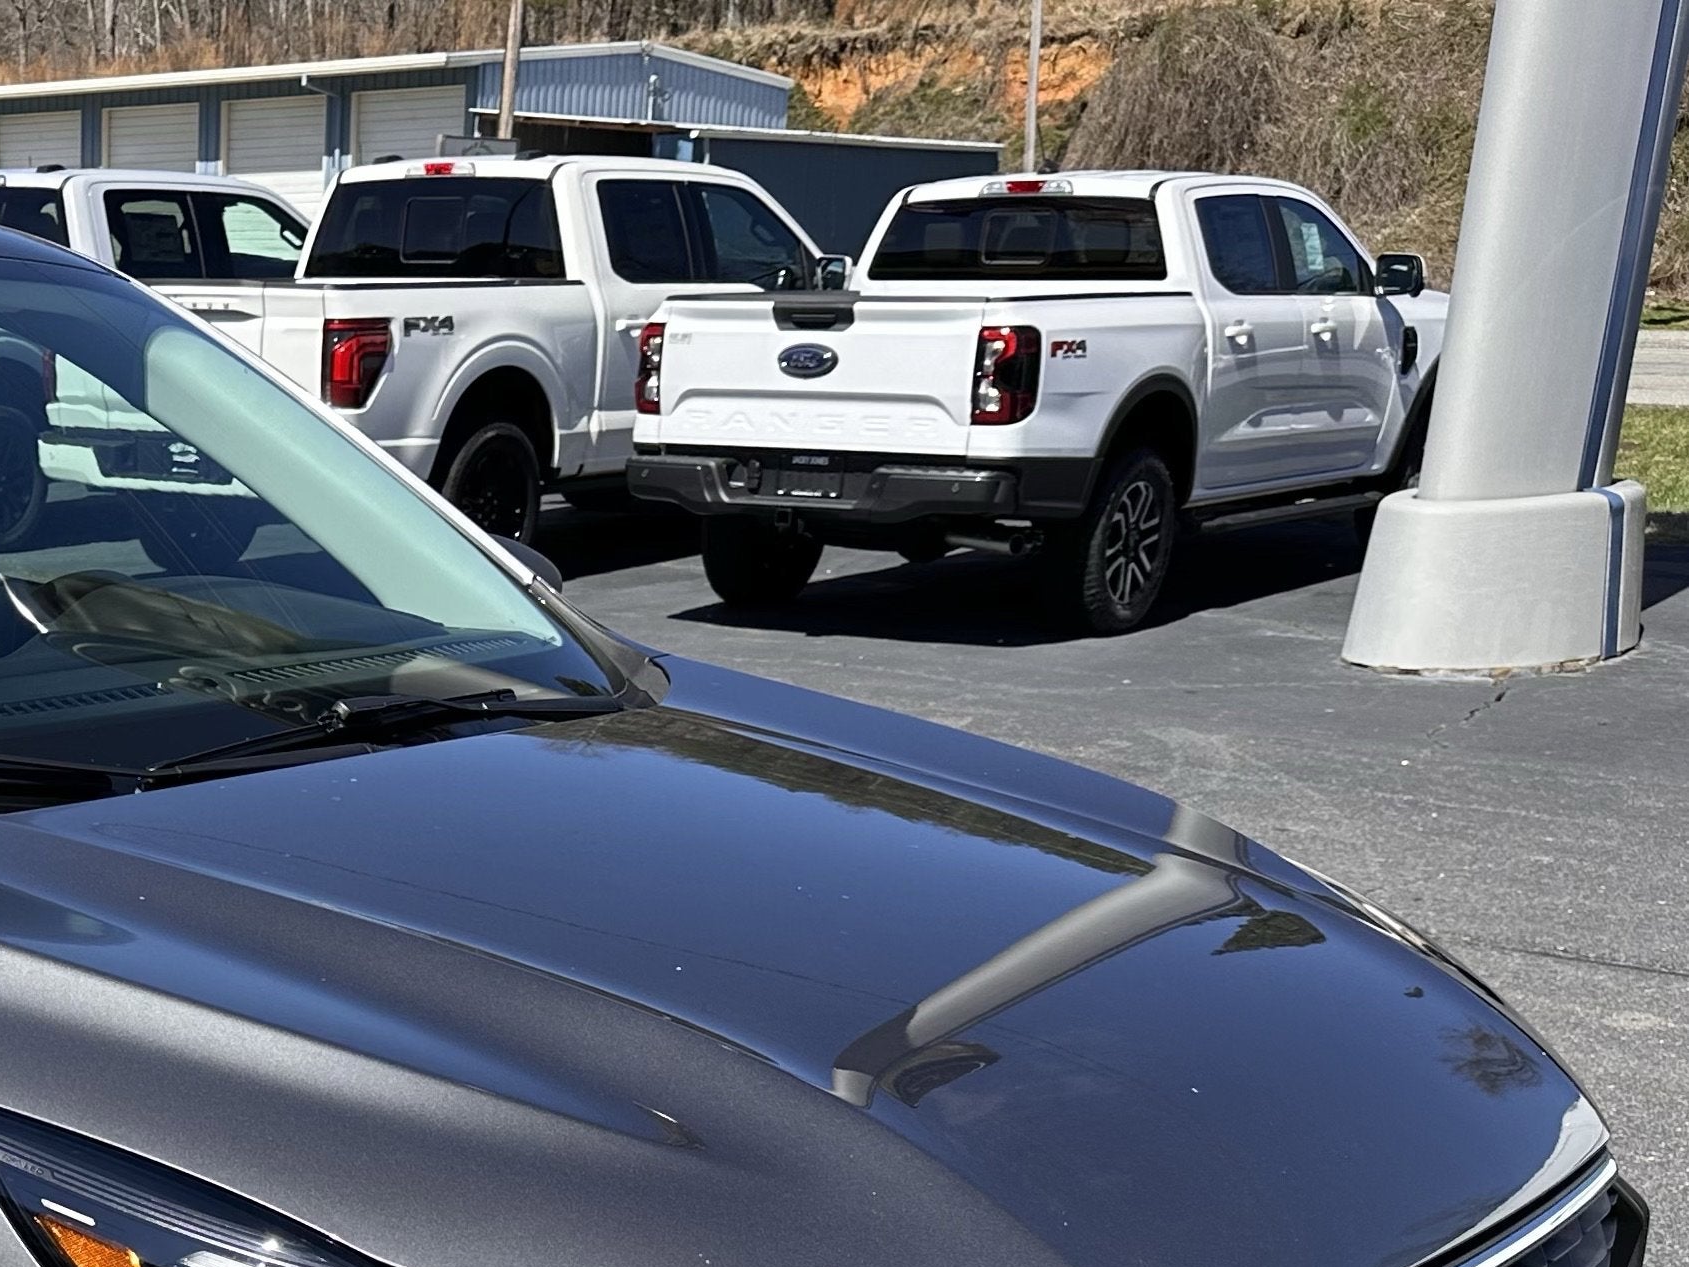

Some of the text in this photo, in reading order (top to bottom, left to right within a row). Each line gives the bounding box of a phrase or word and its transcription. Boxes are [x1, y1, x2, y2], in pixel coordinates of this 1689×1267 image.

[403, 316, 455, 337] FX4
[1051, 340, 1087, 358] FX4
[683, 409, 939, 438] RANGER
